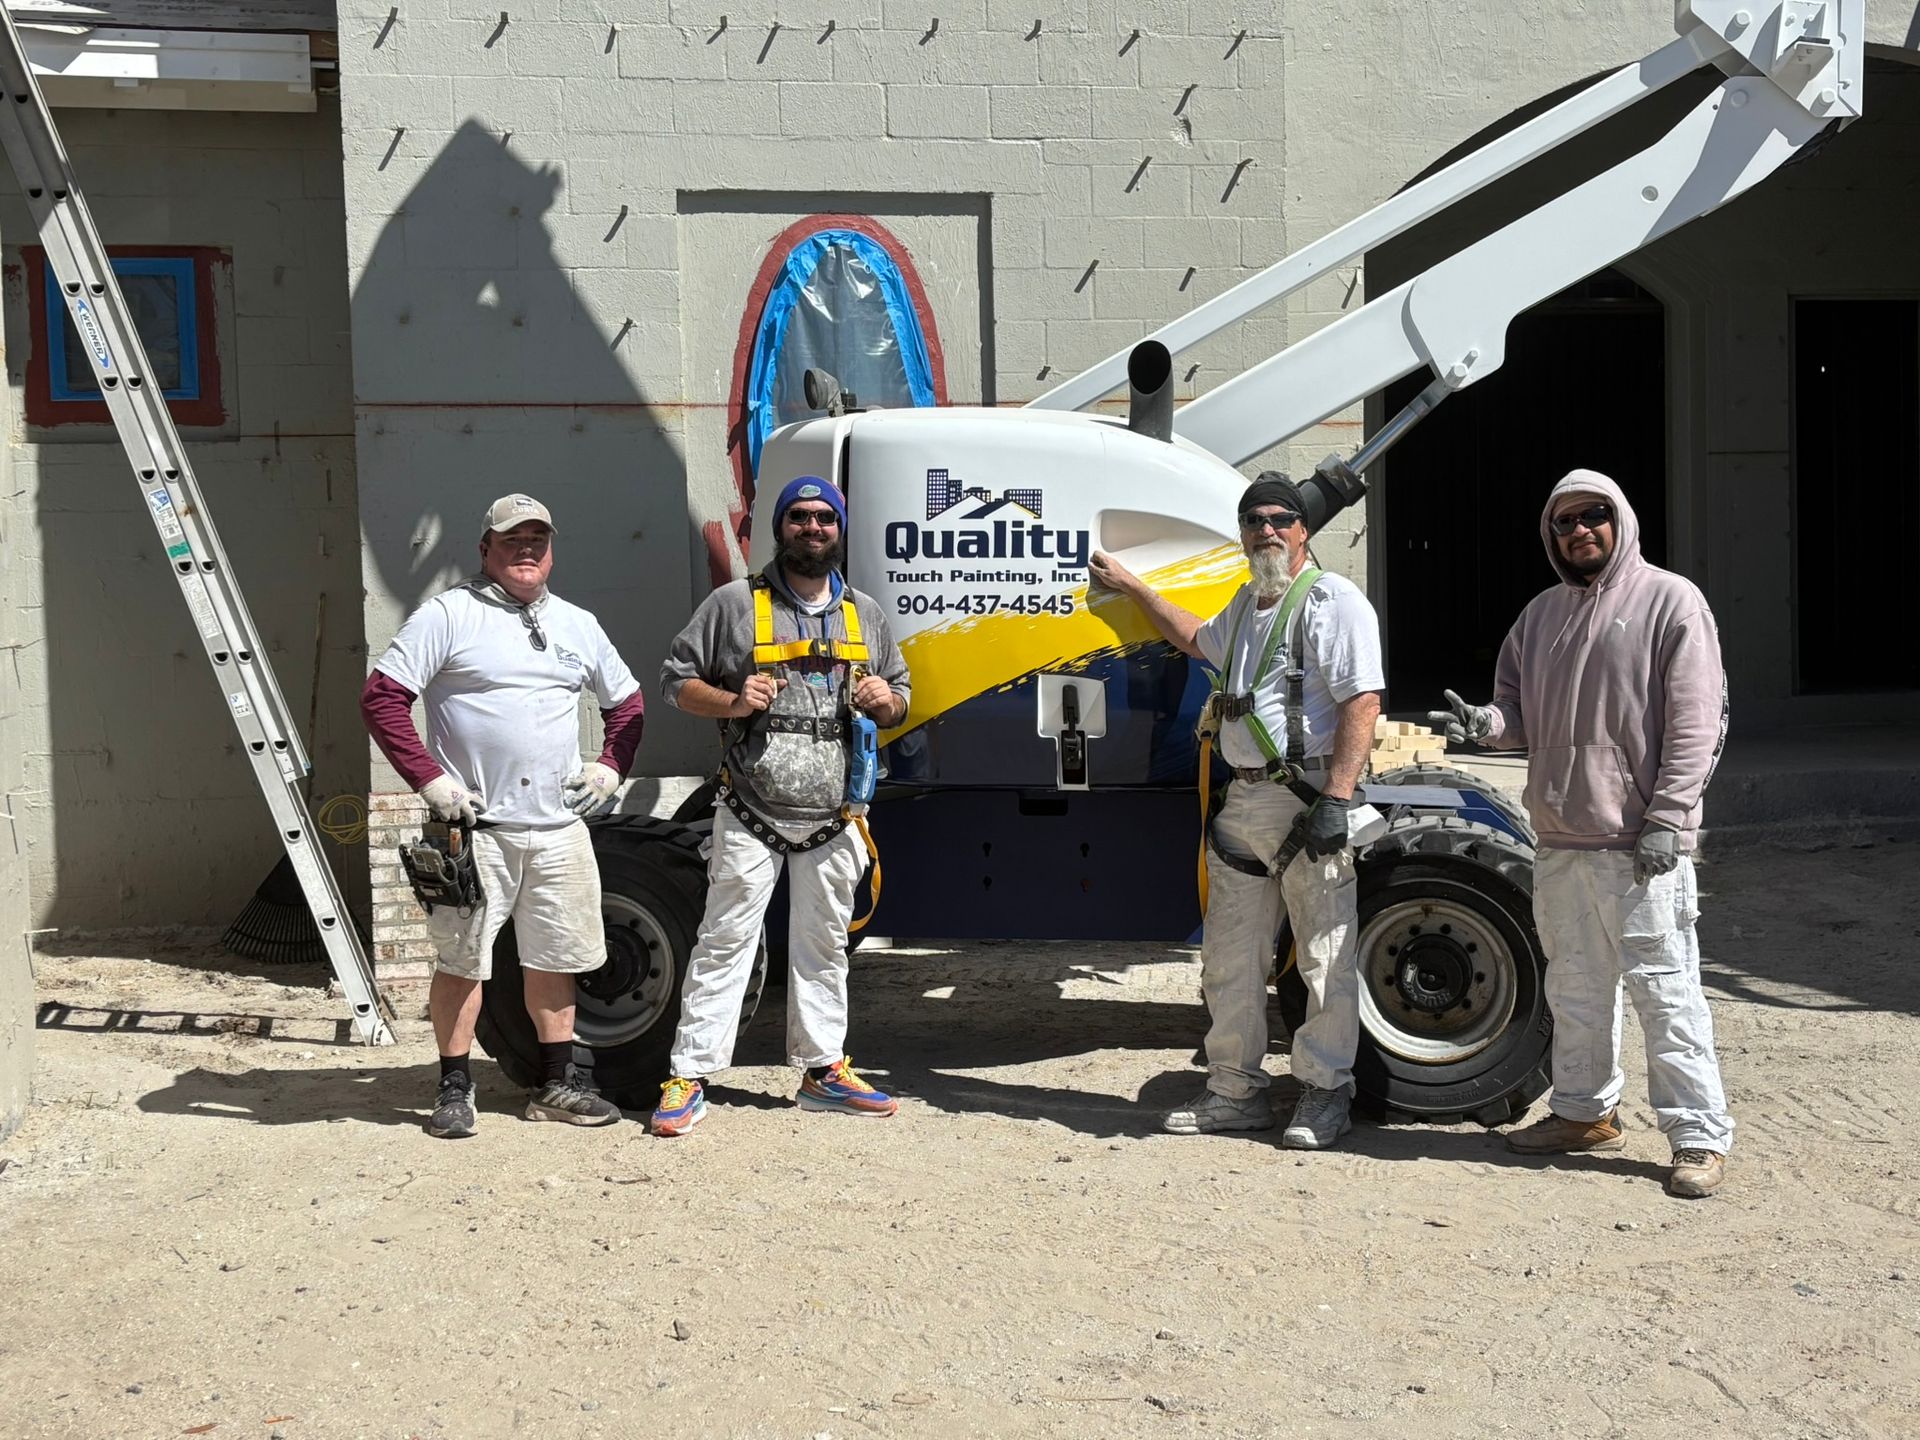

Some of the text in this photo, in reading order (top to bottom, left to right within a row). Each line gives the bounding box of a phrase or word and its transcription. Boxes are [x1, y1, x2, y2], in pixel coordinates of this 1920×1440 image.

[82, 312, 104, 355] WERNER
[885, 520, 1090, 568] Quality
[886, 570, 1088, 585] Touch Painting, Inc.
[896, 594, 1075, 615] 904-437-4545
